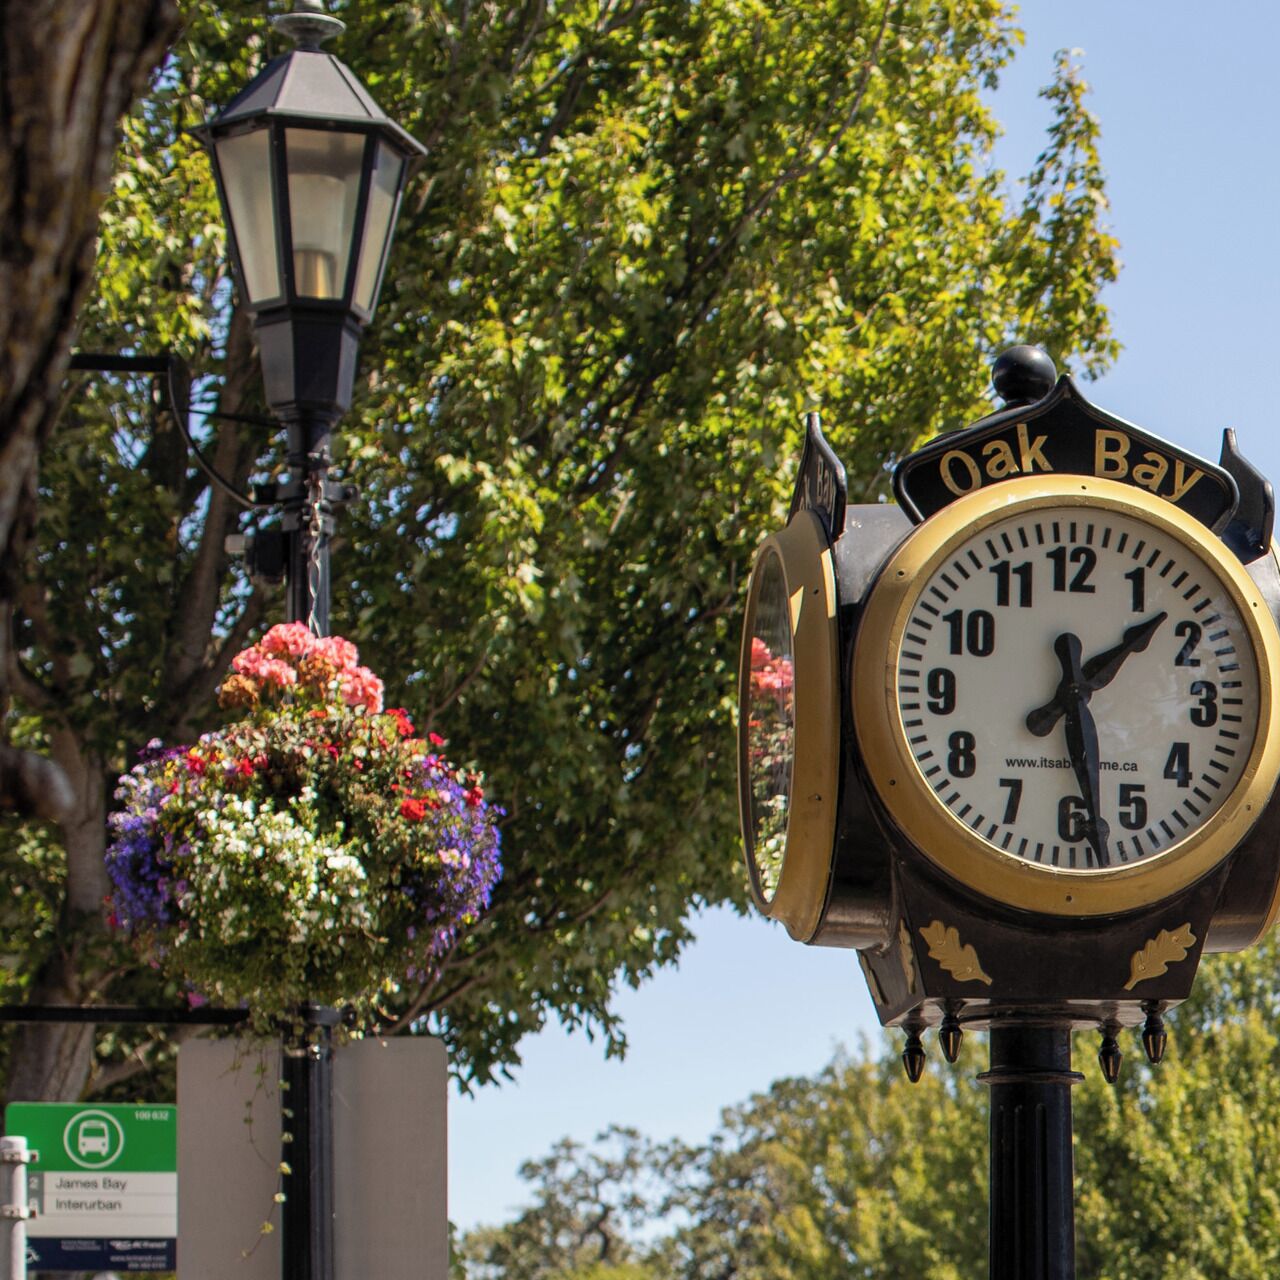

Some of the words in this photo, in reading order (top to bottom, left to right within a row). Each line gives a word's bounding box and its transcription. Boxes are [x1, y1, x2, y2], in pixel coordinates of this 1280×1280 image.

[940, 423, 1054, 498] Oak
[1094, 429, 1205, 503] Bay
[990, 560, 1033, 608] 11
[1046, 546, 1097, 593] 12
[1124, 566, 1145, 612] 1
[943, 609, 995, 657] 10
[1175, 620, 1203, 667] 2
[927, 668, 956, 715] 9
[1189, 680, 1218, 728] 3
[947, 731, 976, 778] 8
[1163, 742, 1193, 788] 4
[999, 778, 1023, 824] 7
[1057, 795, 1092, 843] 6
[1118, 783, 1148, 830] 5
[55, 1177, 99, 1190] James
[102, 1177, 128, 1194] Bay
[55, 1198, 122, 1210] Interurban
